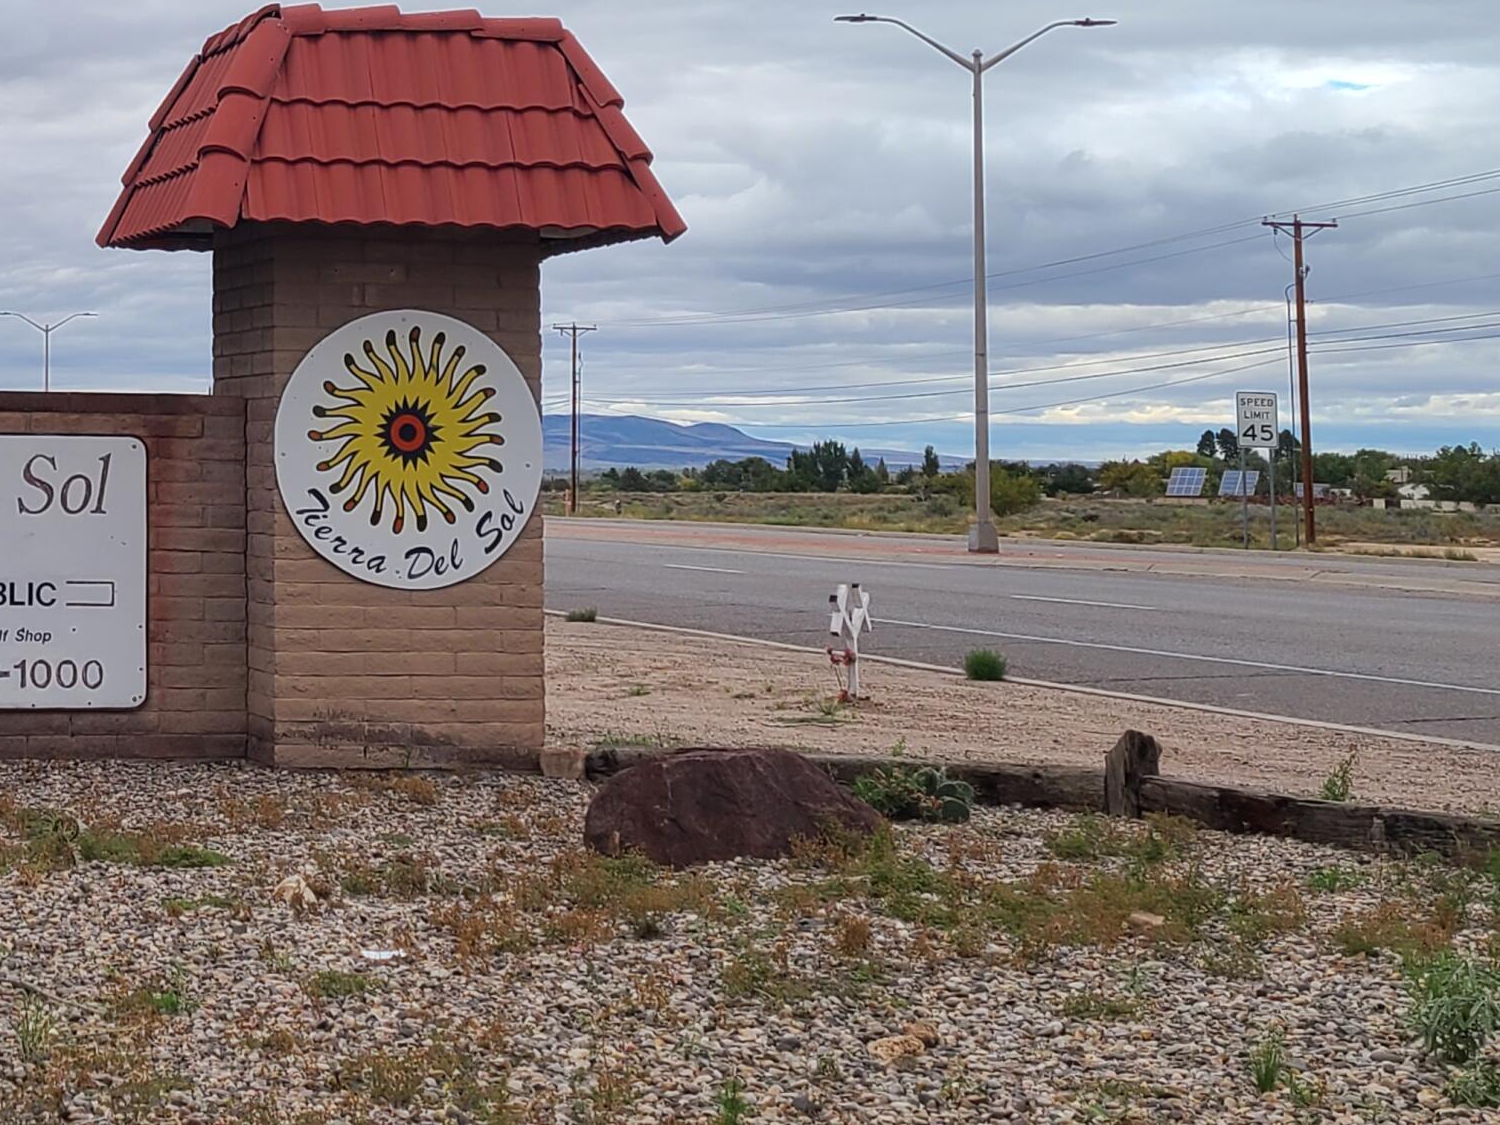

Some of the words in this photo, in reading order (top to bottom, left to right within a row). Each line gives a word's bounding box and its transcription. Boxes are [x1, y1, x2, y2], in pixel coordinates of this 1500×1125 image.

[1240, 398, 1273, 407] SPEED
[1244, 411, 1270, 419] LIMIT
[1242, 424, 1273, 442] 45
[17, 452, 113, 515] Sol
[295, 488, 387, 574] Tierra
[404, 538, 464, 579] Del
[15, 629, 52, 644] Shop
